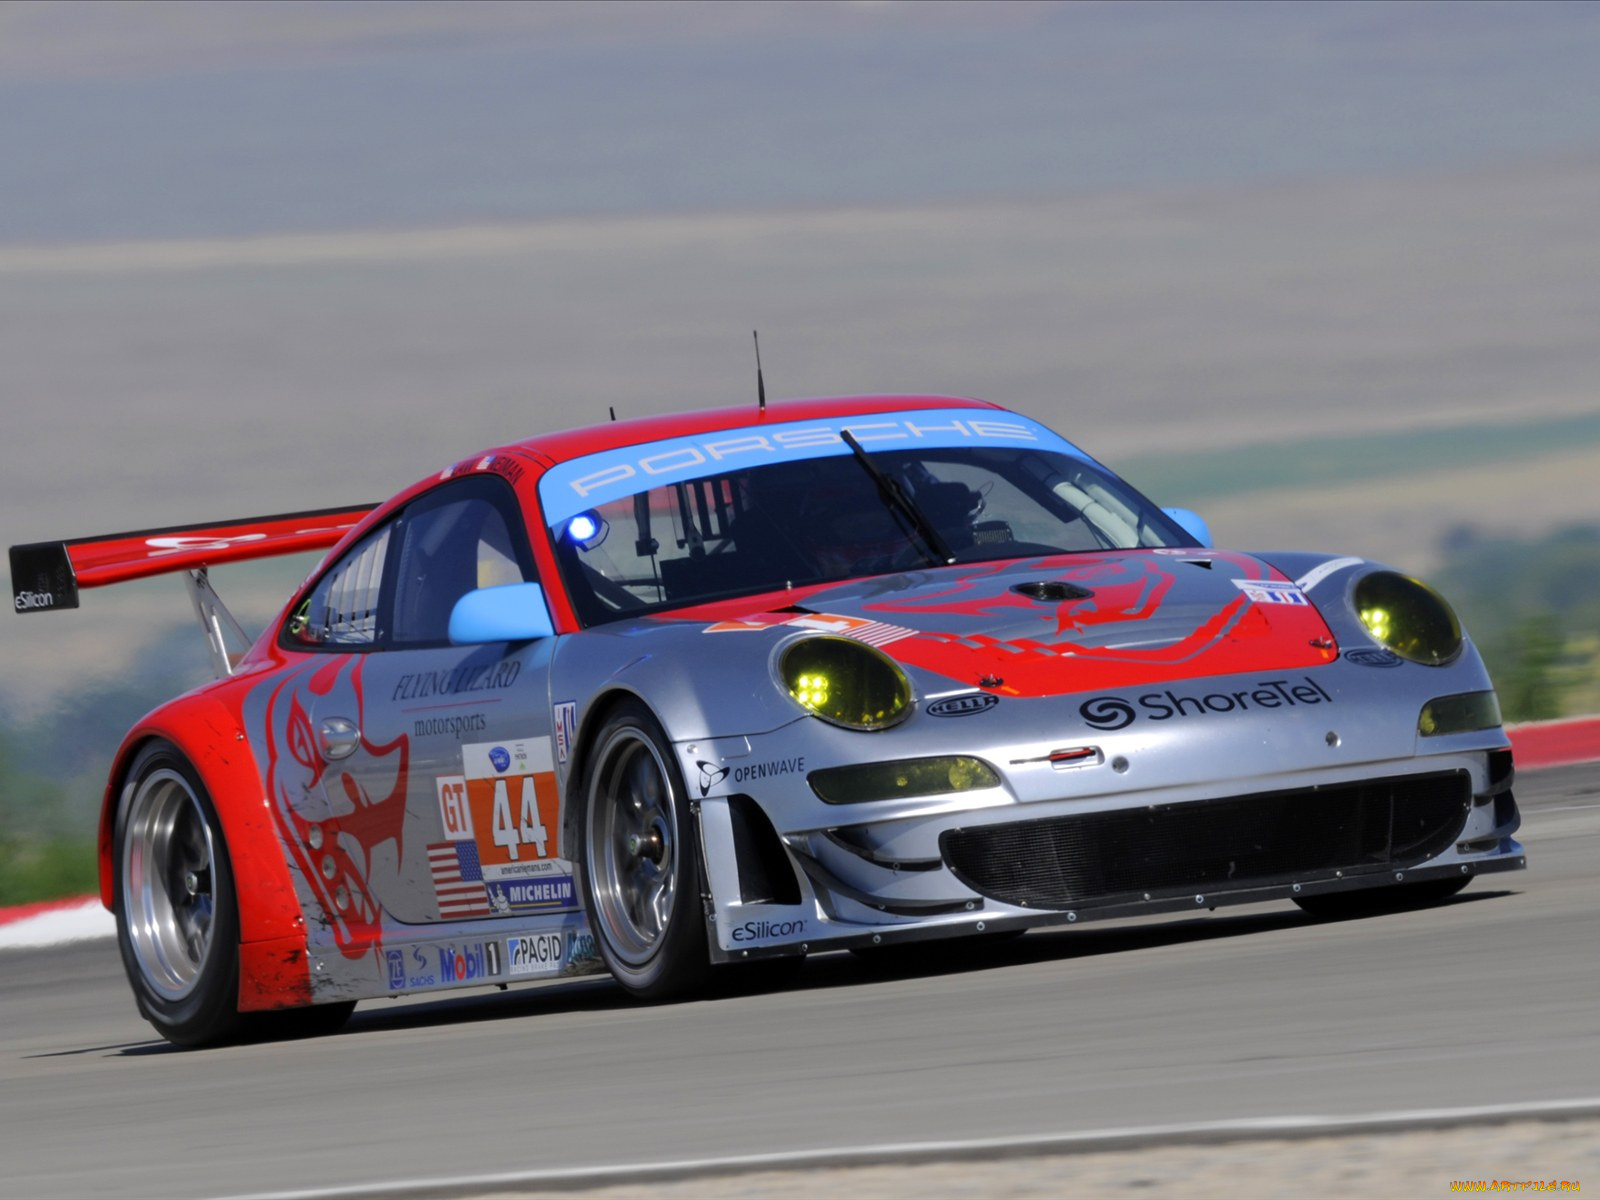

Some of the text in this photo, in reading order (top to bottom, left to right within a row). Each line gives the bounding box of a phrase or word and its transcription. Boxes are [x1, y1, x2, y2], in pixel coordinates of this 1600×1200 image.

[568, 419, 1039, 498] PORSCHE
[15, 590, 54, 609] eSilicon
[392, 661, 521, 701] FLYING LIZARD
[1138, 676, 1333, 721] ShoreTel
[414, 713, 487, 740] motorsports
[734, 757, 805, 783] OPENWAVE
[441, 782, 468, 834] GT
[492, 774, 549, 861] 44
[509, 882, 572, 902] MICHELIN
[731, 919, 804, 942] eSilicon
[439, 942, 498, 983] Mobil 1
[519, 935, 562, 965] PAGID
[409, 975, 435, 988] SACHS
